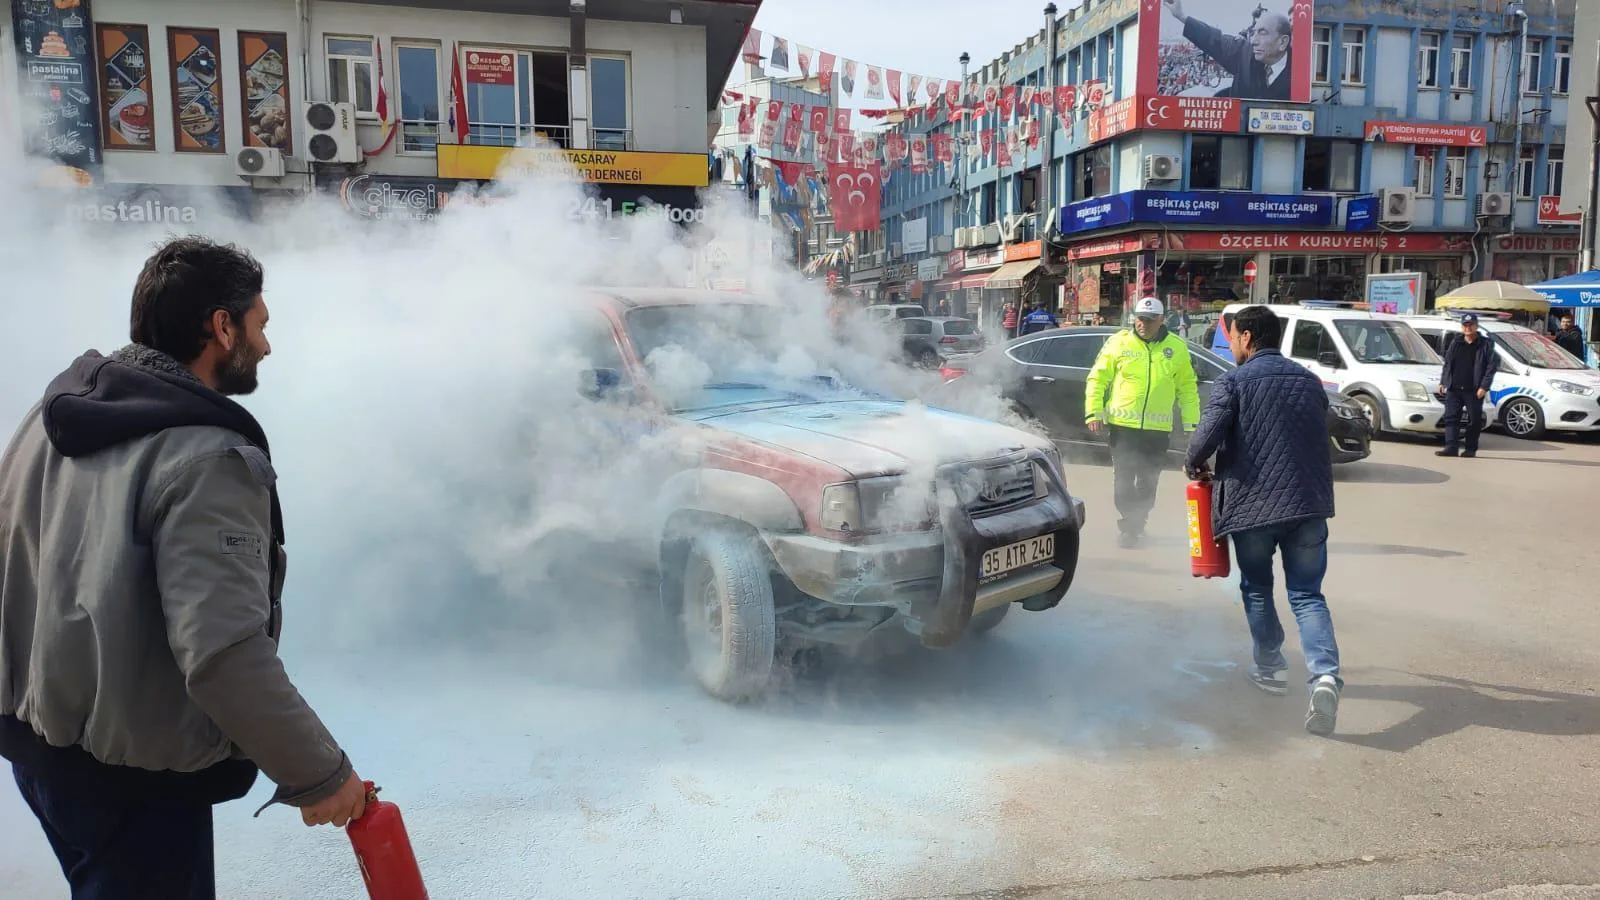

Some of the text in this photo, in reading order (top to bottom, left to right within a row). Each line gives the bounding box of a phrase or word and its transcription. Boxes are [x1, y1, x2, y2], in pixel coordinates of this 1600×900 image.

[32, 64, 79, 75] pastalina
[1178, 97, 1232, 109] MİLLİYETÇİ
[1184, 109, 1227, 119] HAREKET
[1184, 119, 1222, 128] PARTİSİ
[1386, 125, 1466, 136] YENİDEN REFAH PARTİSİ
[594, 168, 642, 181] DERNEĞİ
[1147, 197, 1220, 211] BEŞİKTAŞ ÇARŞI
[1248, 200, 1318, 213] BEŞİKTAŞ ÇARŞI
[1219, 234, 1407, 249] ÖZÇELİK KURUYEMİŞ 2
[985, 537, 1053, 574] 35 ATR 240
